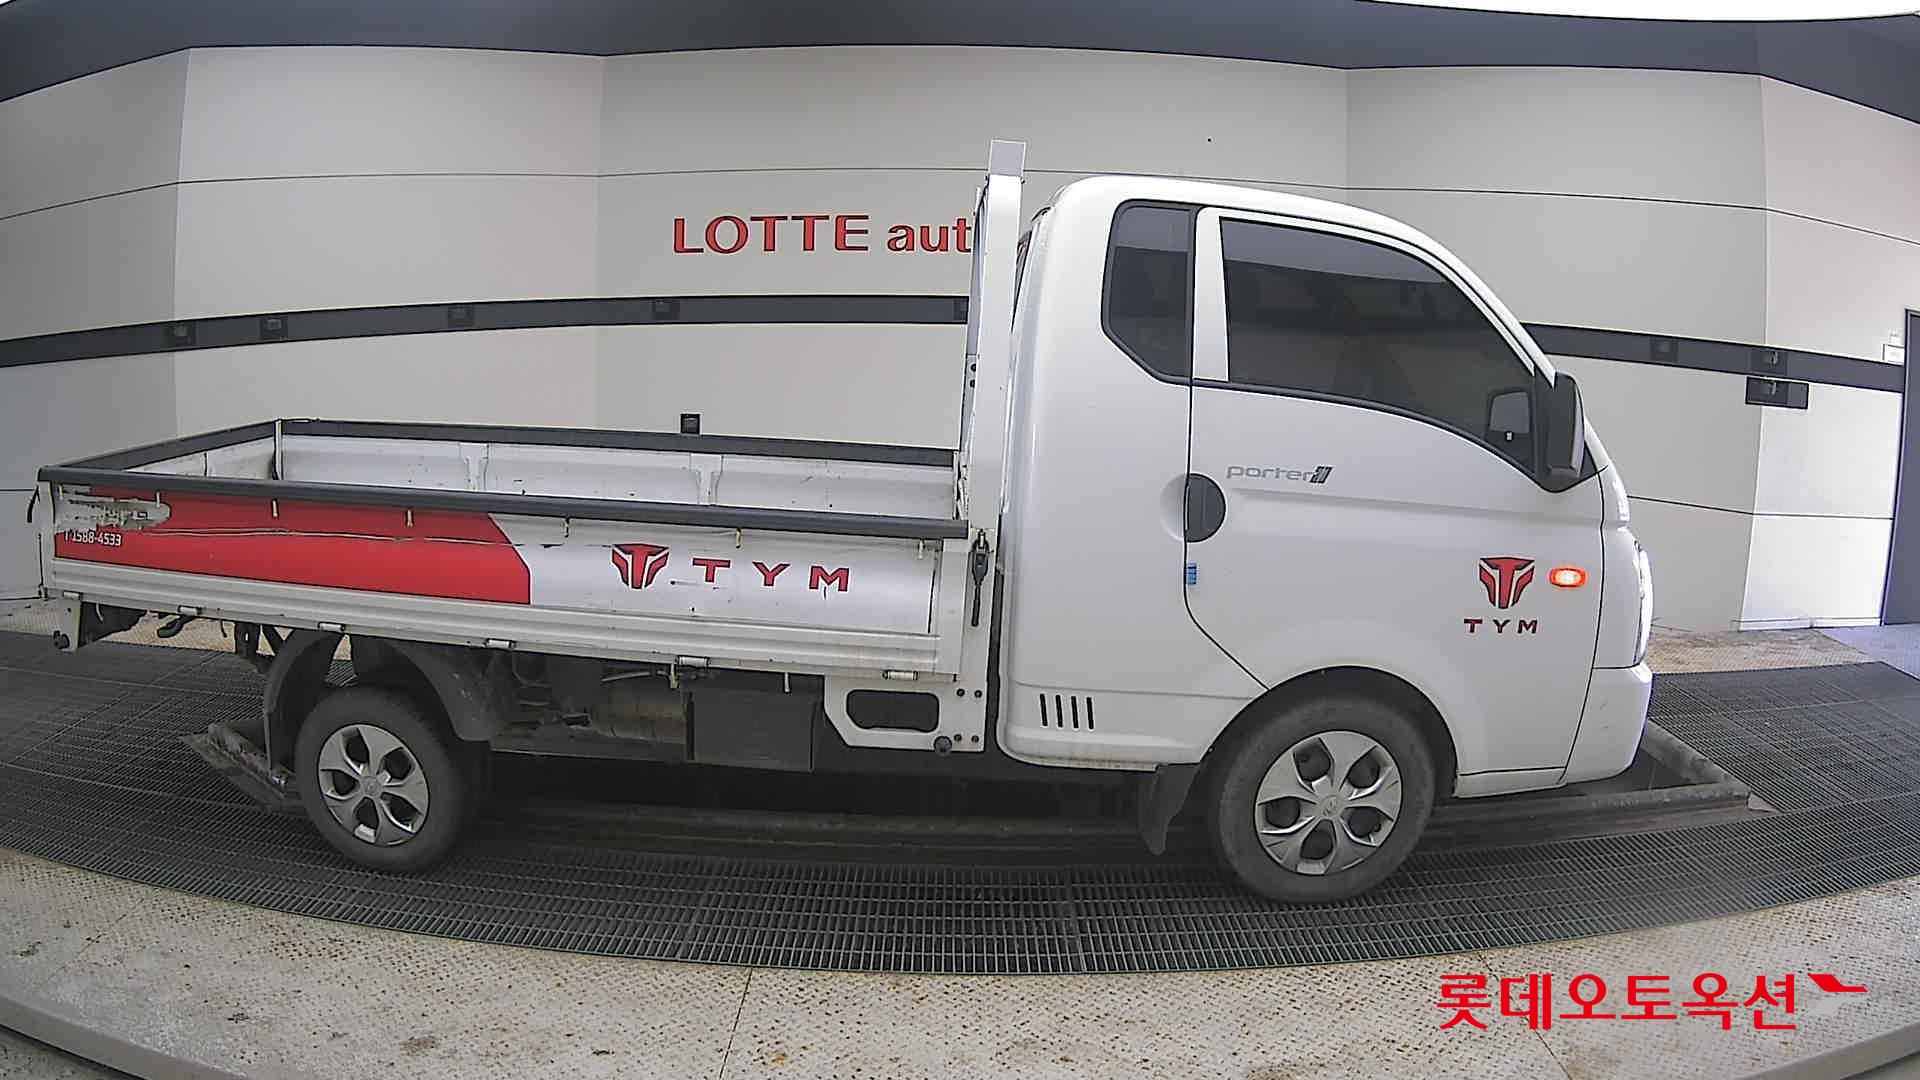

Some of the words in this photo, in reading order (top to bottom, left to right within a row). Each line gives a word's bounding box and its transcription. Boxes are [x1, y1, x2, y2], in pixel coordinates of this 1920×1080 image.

[672, 215, 870, 254] LOTTE
[886, 218, 973, 253] aut
[1226, 465, 1312, 482] porter
[692, 557, 850, 593] TYM
[1463, 618, 1538, 634] TYM
